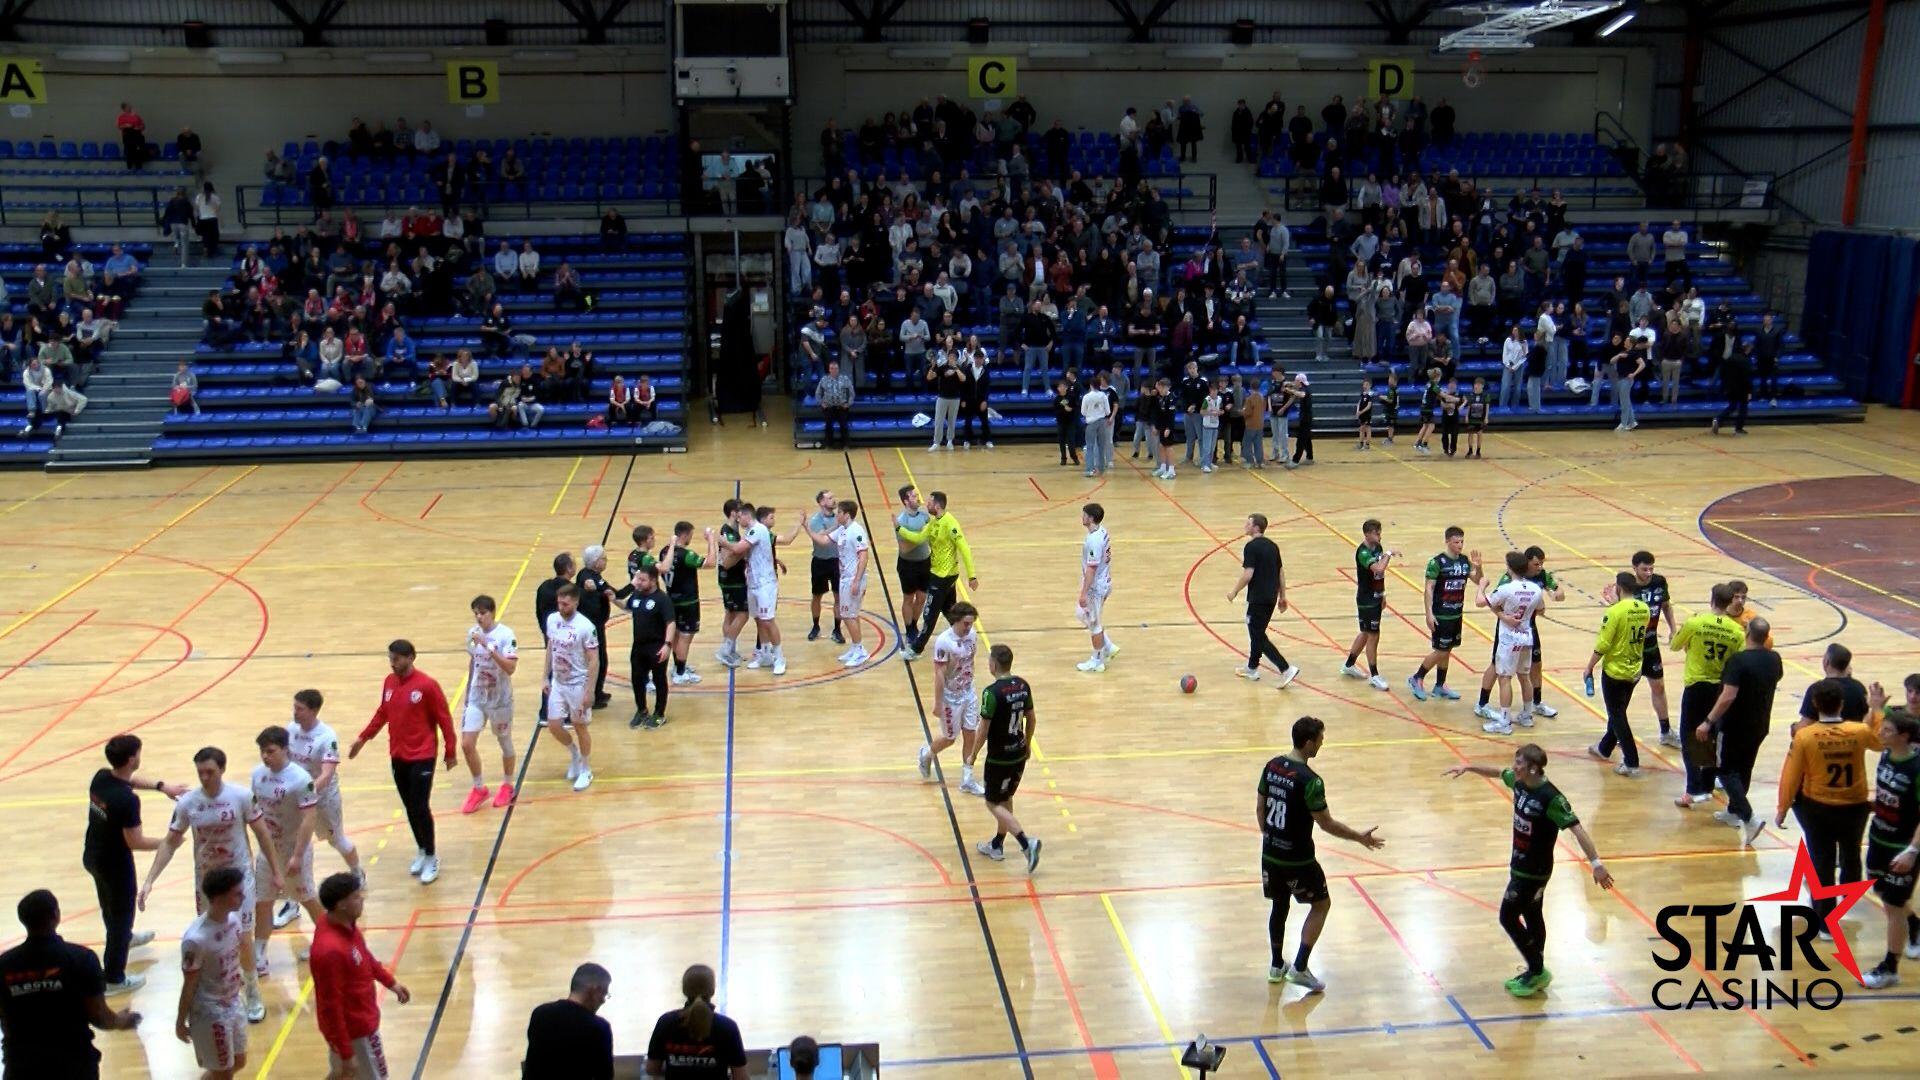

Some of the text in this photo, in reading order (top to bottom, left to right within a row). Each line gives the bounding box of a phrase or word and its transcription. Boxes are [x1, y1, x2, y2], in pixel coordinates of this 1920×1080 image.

[1, 63, 35, 98] A
[459, 66, 488, 98] B
[979, 61, 1006, 94] C
[1379, 64, 1404, 95] D
[1703, 640, 1728, 660] 37
[1827, 763, 1854, 788] 21
[221, 810, 236, 823] 21
[1266, 797, 1287, 830] 28
